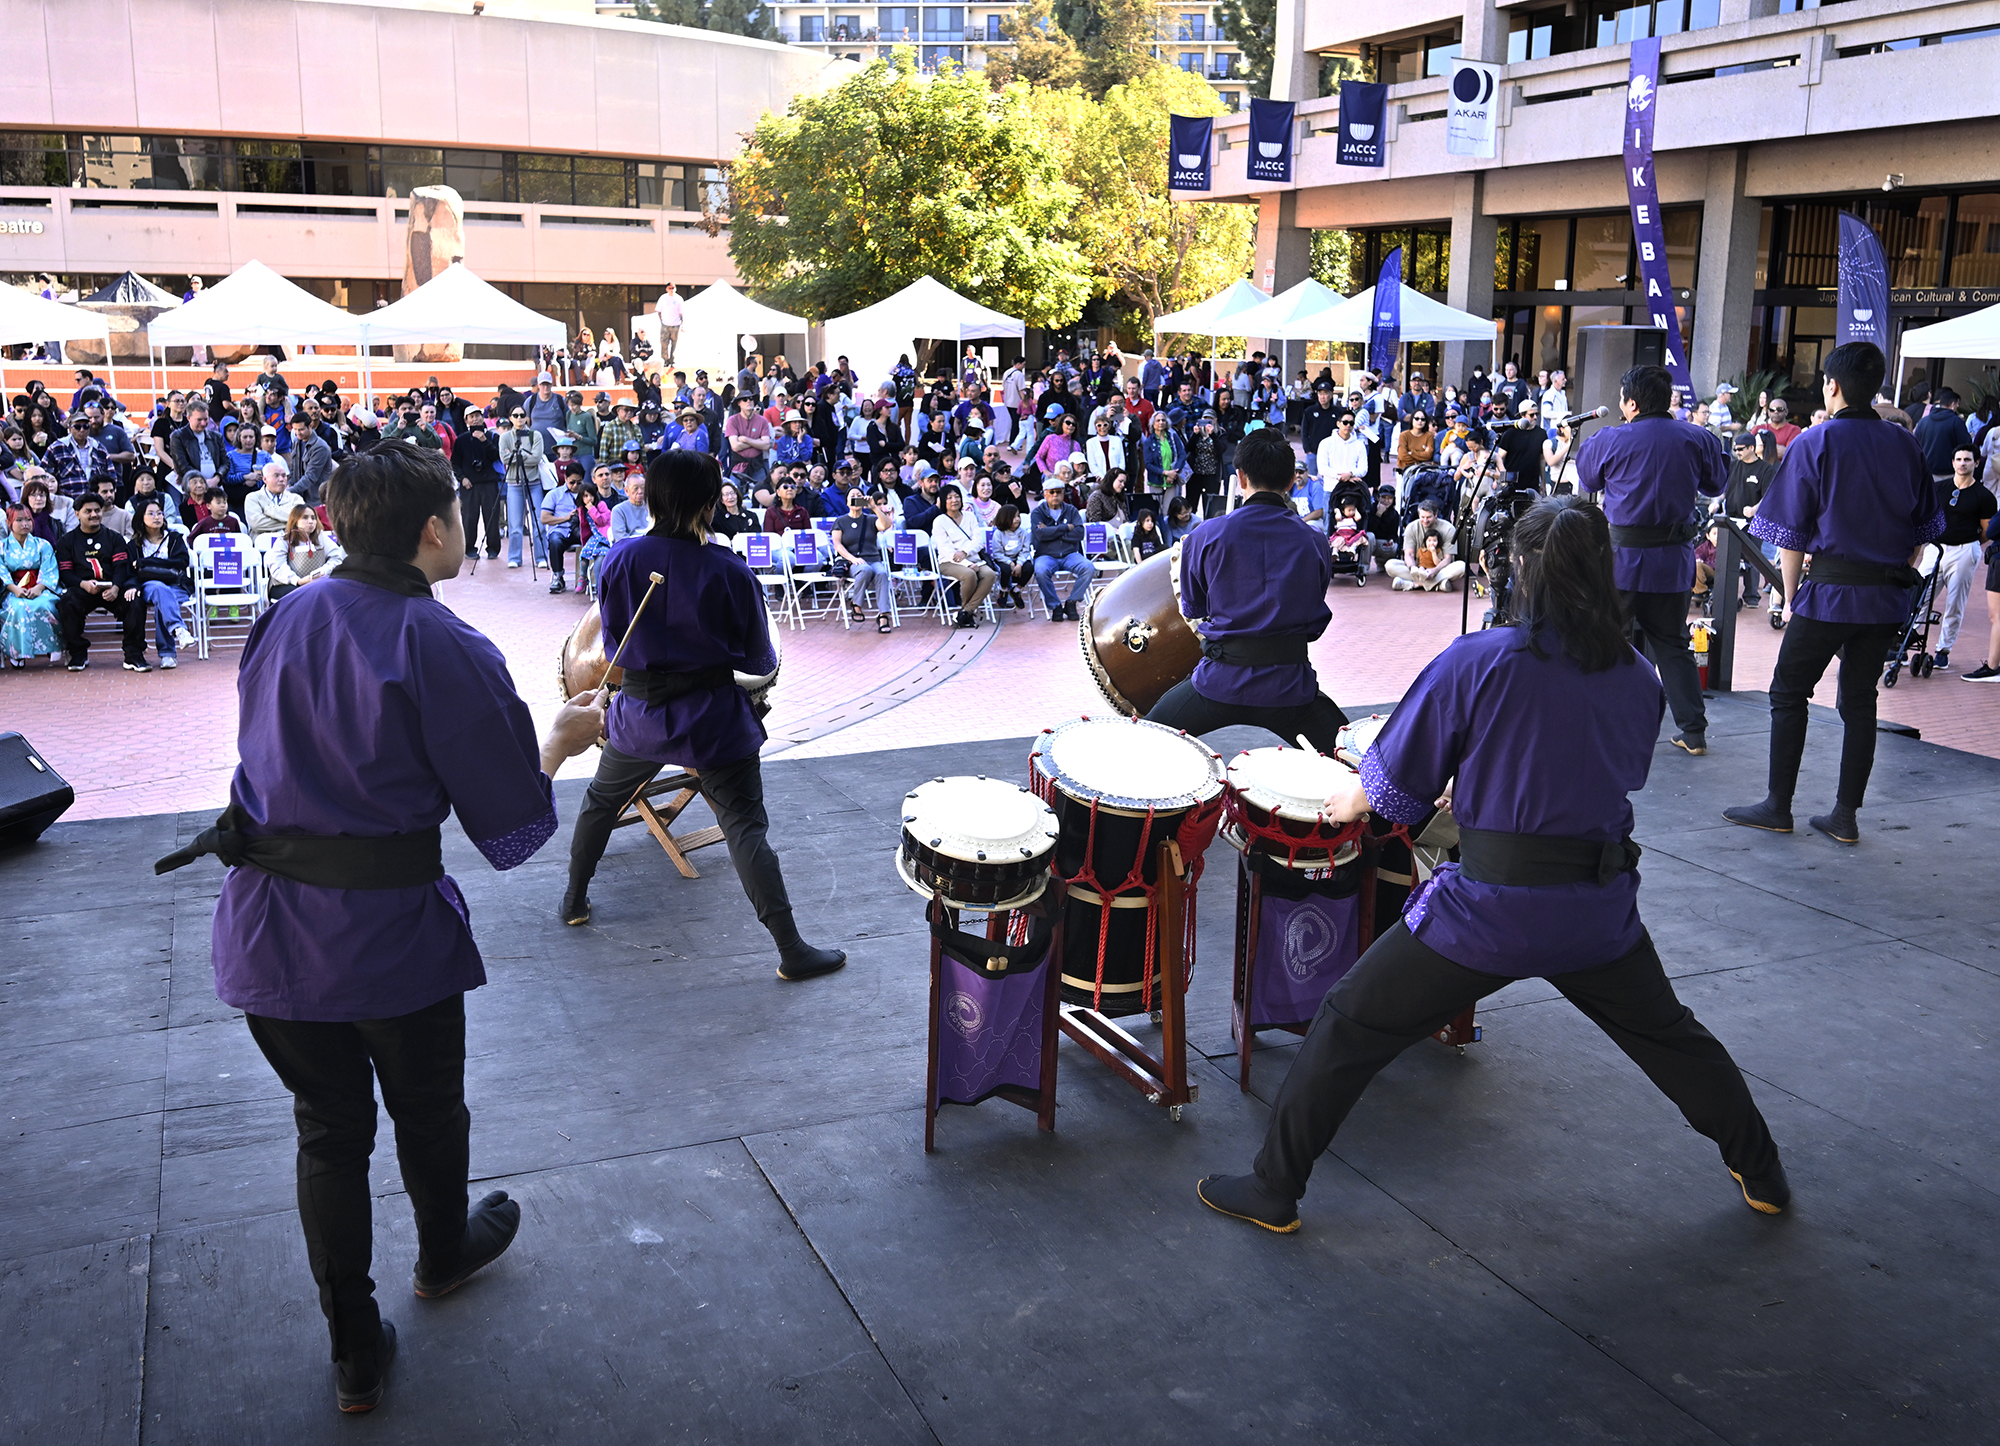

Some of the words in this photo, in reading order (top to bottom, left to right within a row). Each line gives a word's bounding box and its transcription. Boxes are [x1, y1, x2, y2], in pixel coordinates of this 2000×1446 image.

[1454, 109, 1487, 120] AKARI
[1342, 143, 1377, 155] JACCC
[1254, 160, 1285, 171] JACCC
[1173, 171, 1204, 181] JACCC
[1632, 128, 1678, 367] IKEBANA
[1915, 290, 1954, 302] Cultural
[1959, 290, 1967, 302] &
